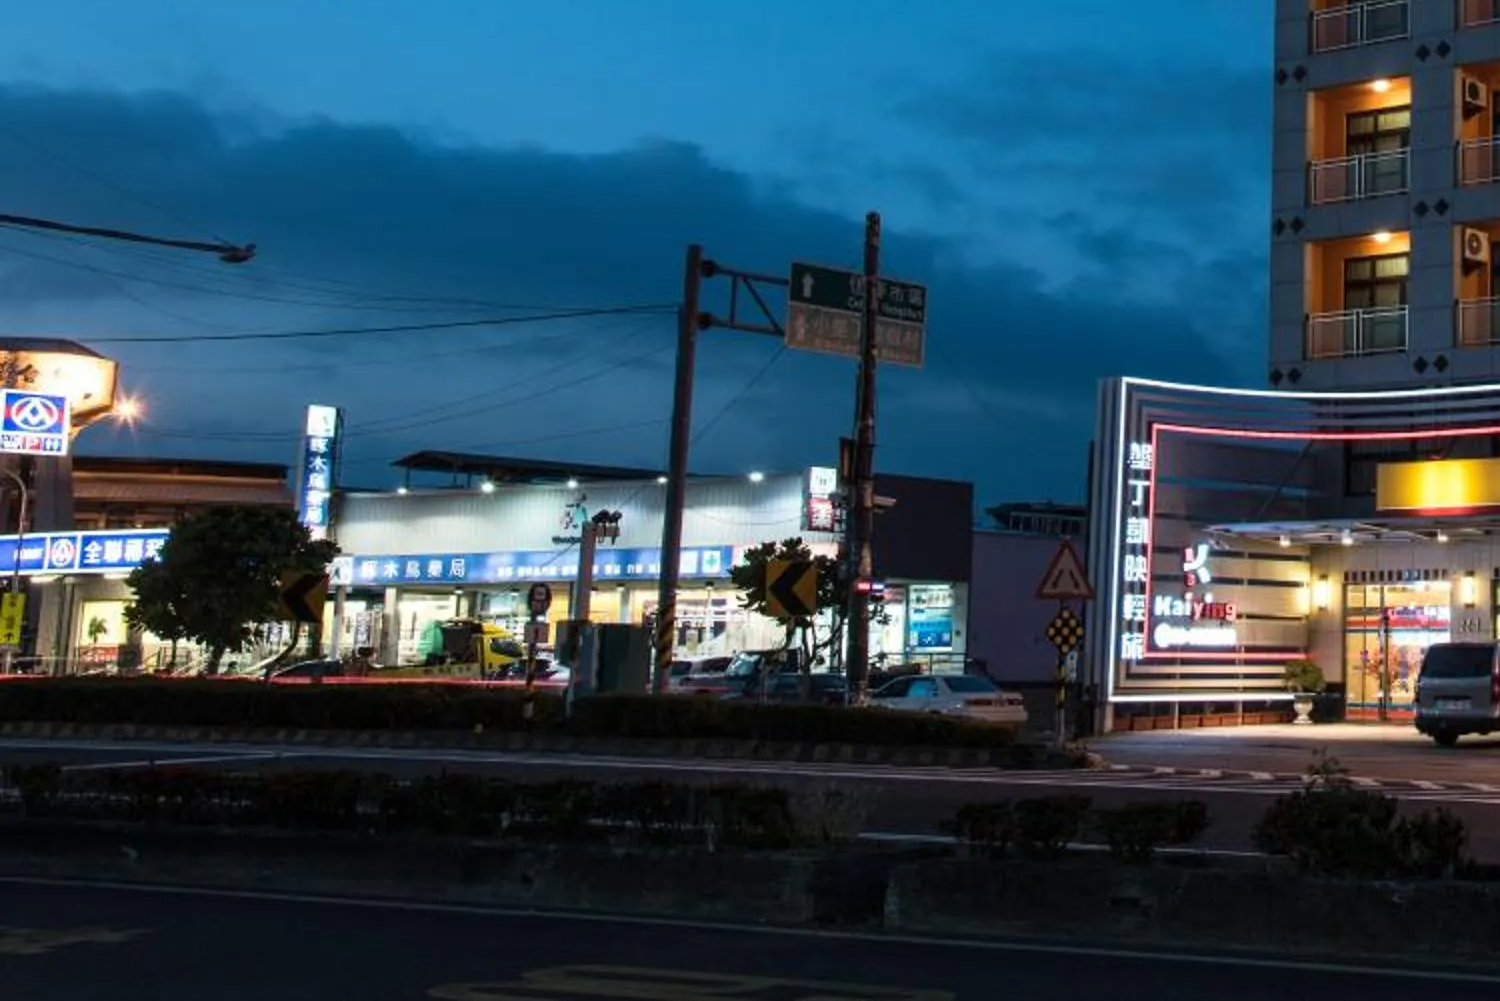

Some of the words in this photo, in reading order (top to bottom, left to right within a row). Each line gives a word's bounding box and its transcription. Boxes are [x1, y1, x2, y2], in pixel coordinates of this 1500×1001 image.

[1121, 442, 1153, 661] 墾丁凱映輕旅
[1154, 593, 1238, 622] Kaiying
